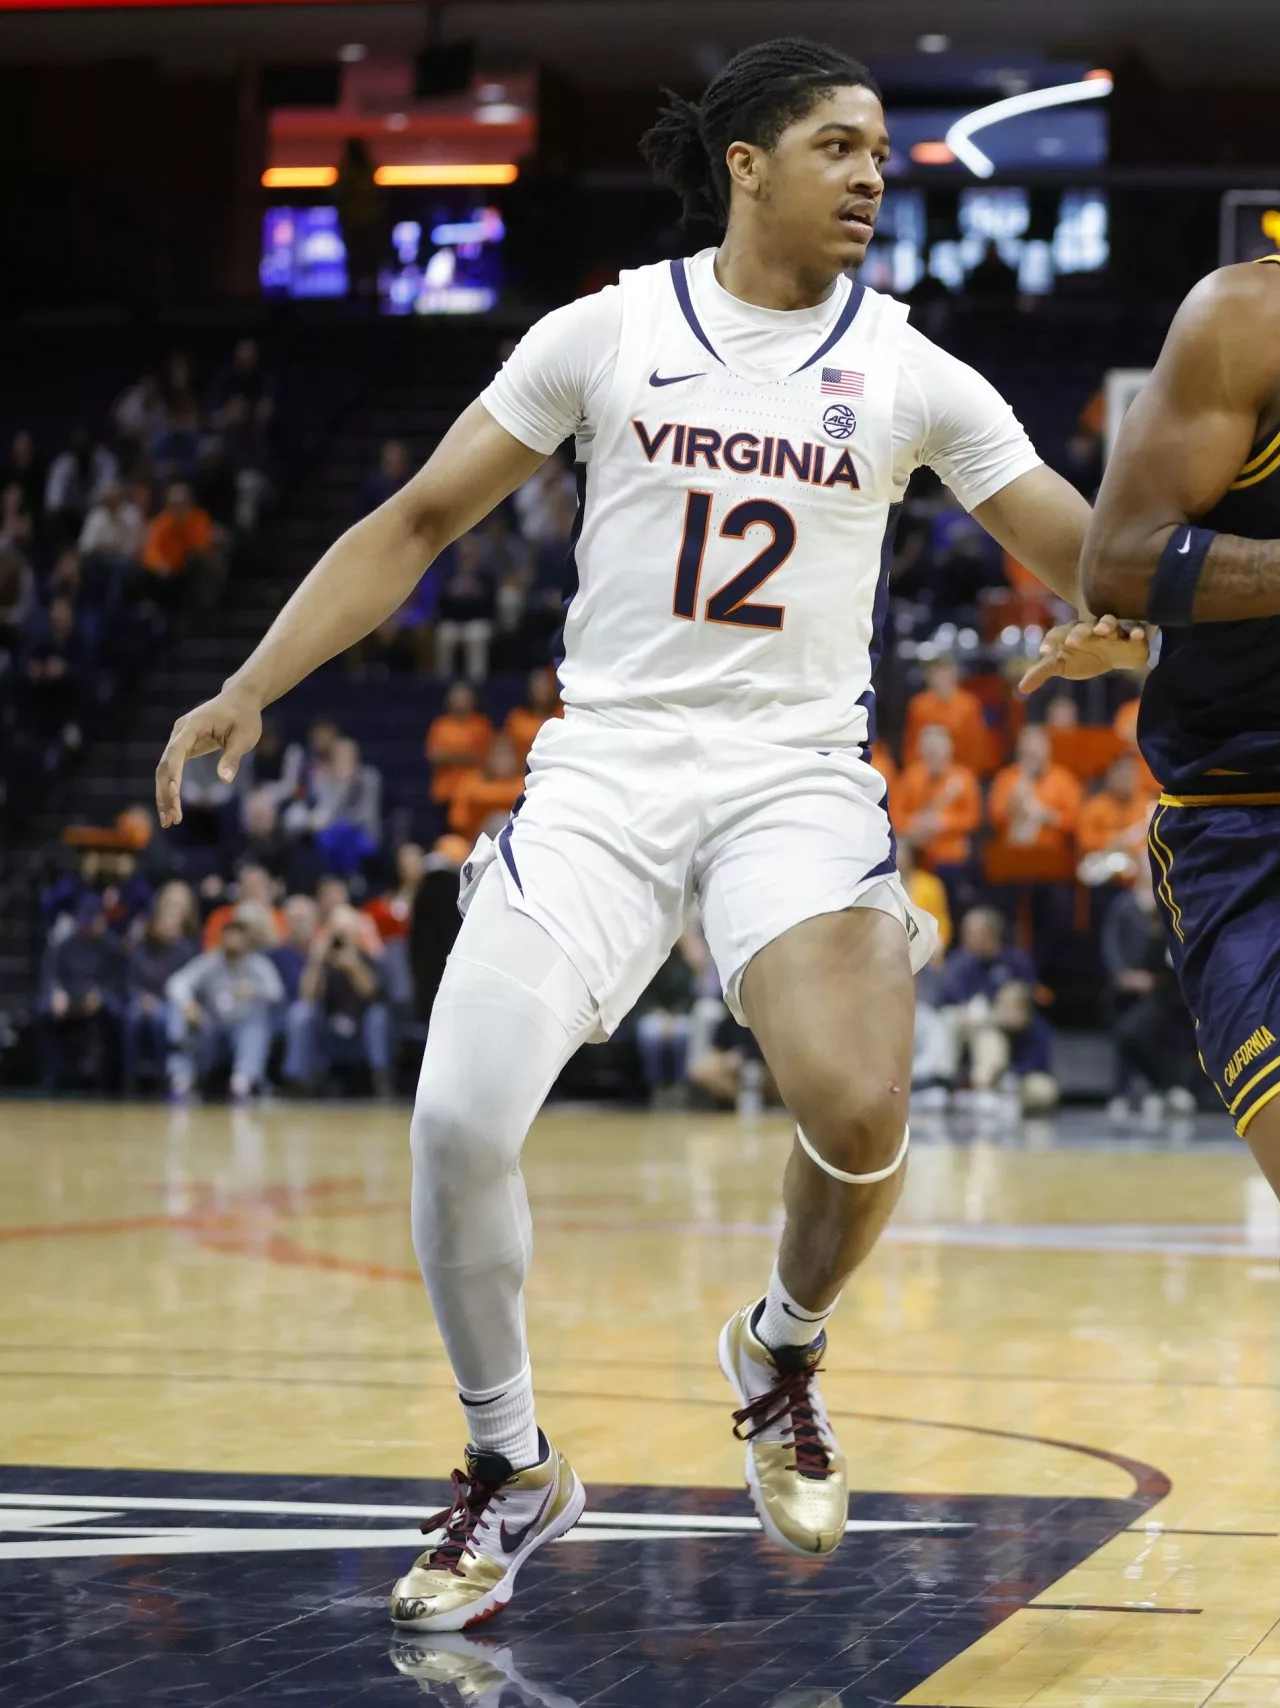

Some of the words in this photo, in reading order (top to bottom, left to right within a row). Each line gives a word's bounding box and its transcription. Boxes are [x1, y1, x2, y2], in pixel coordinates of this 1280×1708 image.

[632, 419, 861, 491] VIRGINIA
[672, 488, 798, 631] 12
[1224, 1024, 1277, 1088] CALIFORNIA
